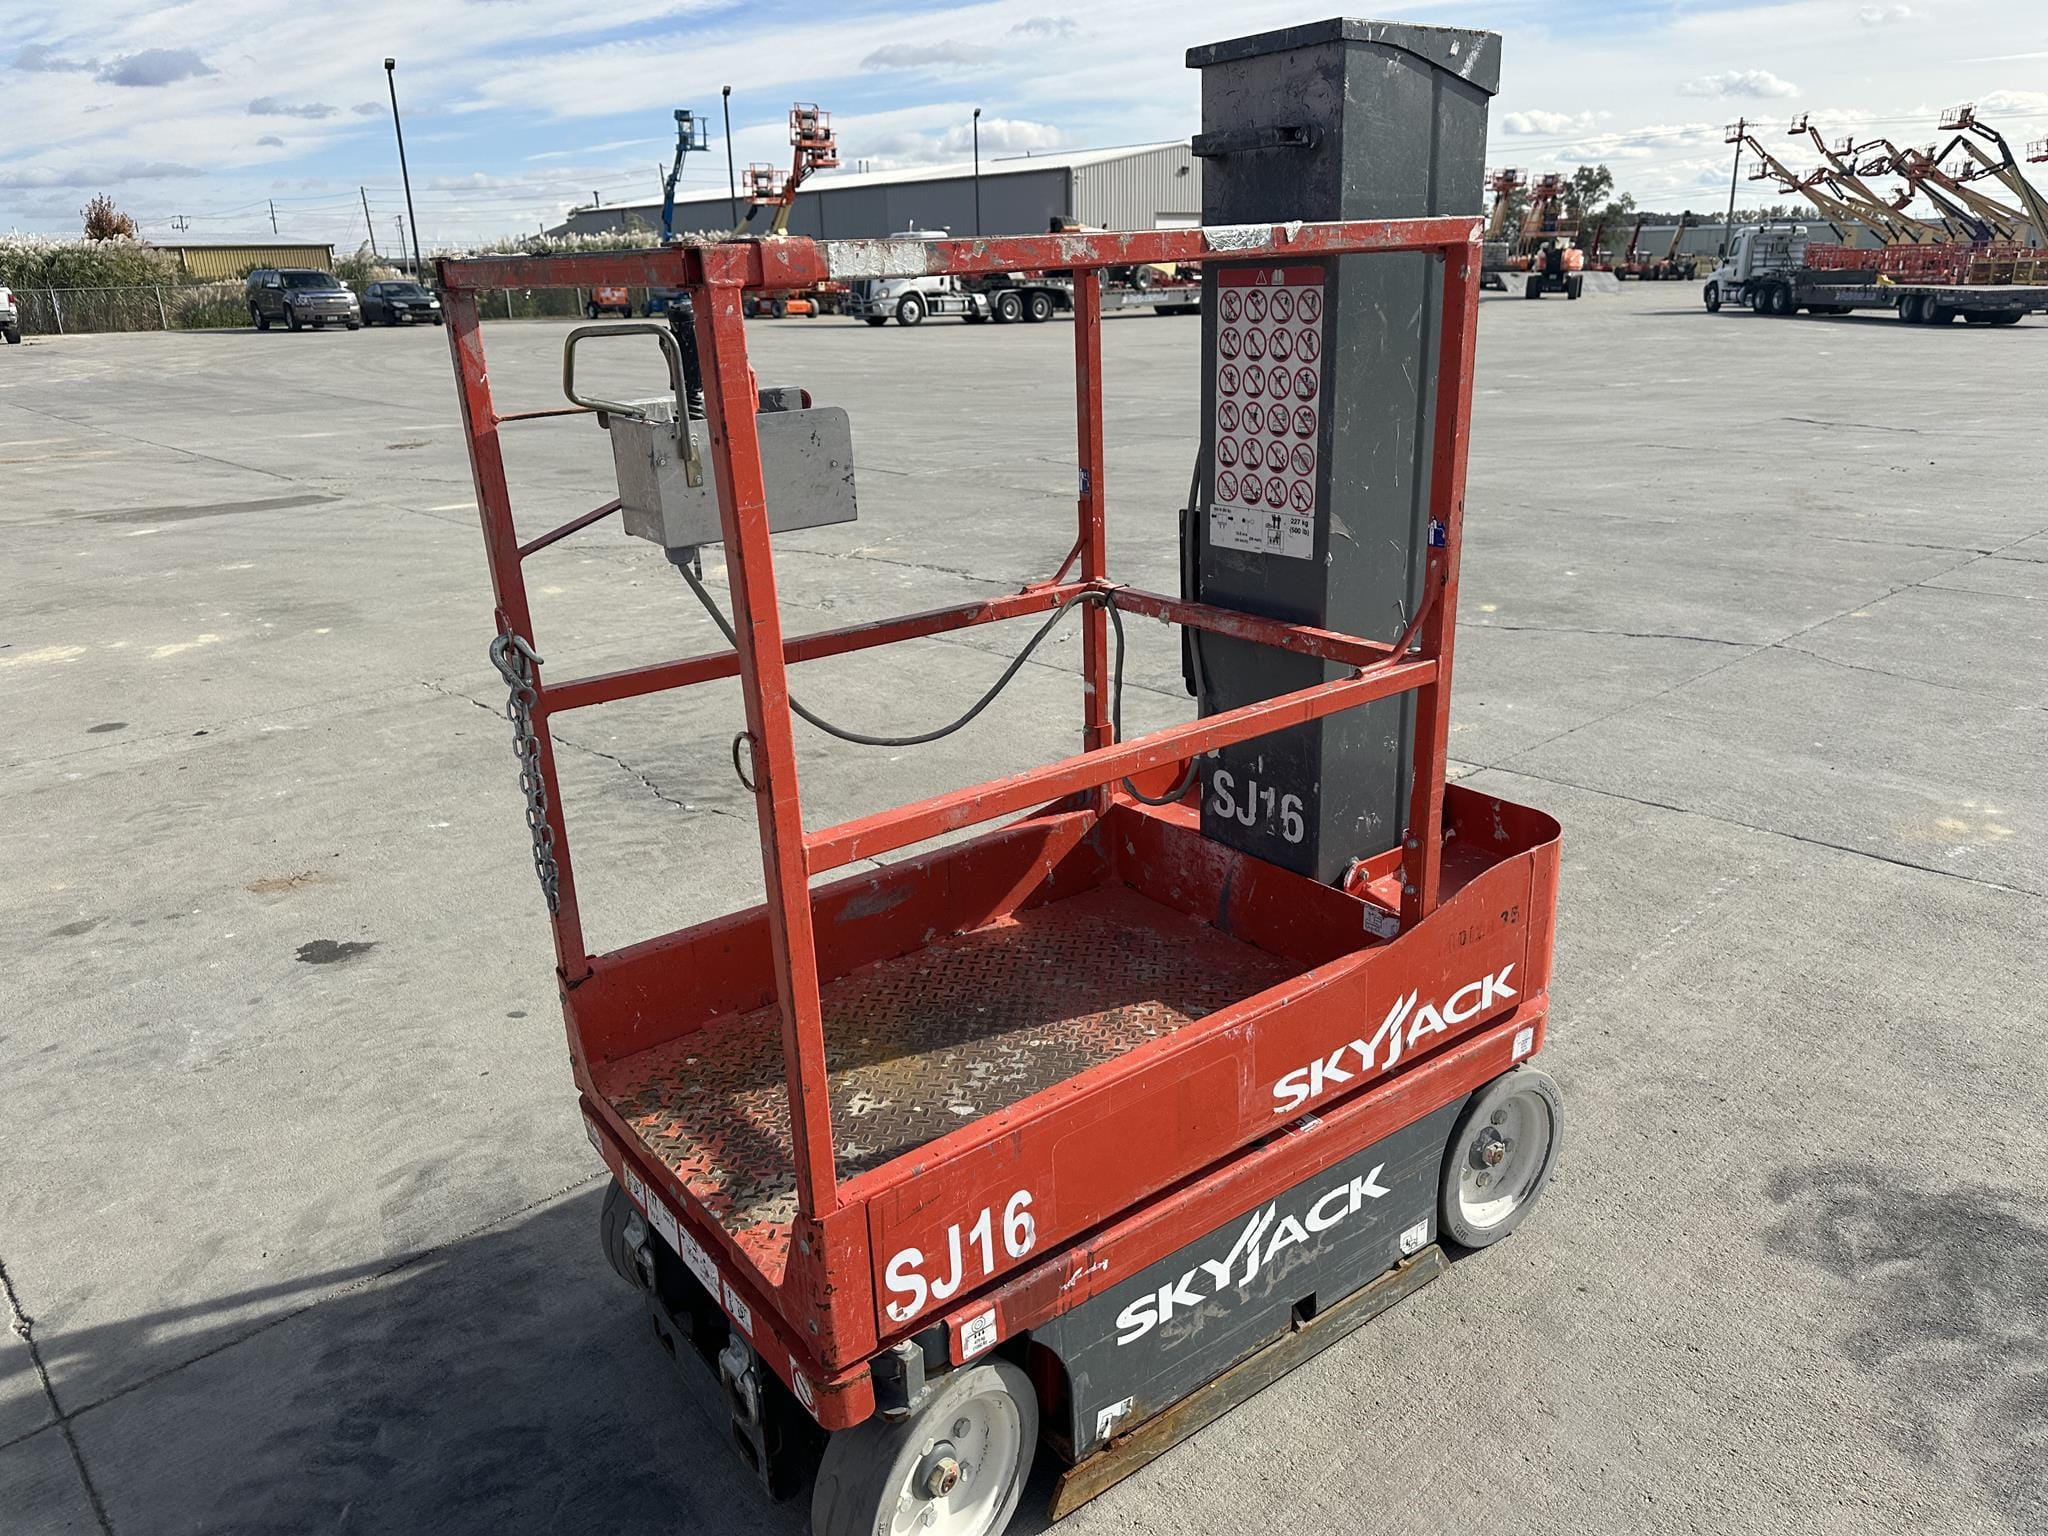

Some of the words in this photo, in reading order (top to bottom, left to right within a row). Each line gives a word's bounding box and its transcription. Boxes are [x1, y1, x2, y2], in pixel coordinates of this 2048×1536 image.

[1289, 527, 1301, 535] (500
[1302, 519, 1309, 528] kg
[1212, 769, 1305, 844] SJ16
[1272, 962, 1518, 1115] SKYJACK
[884, 1189, 1036, 1322] SJ16
[1115, 1162, 1391, 1346] SKYJACK
